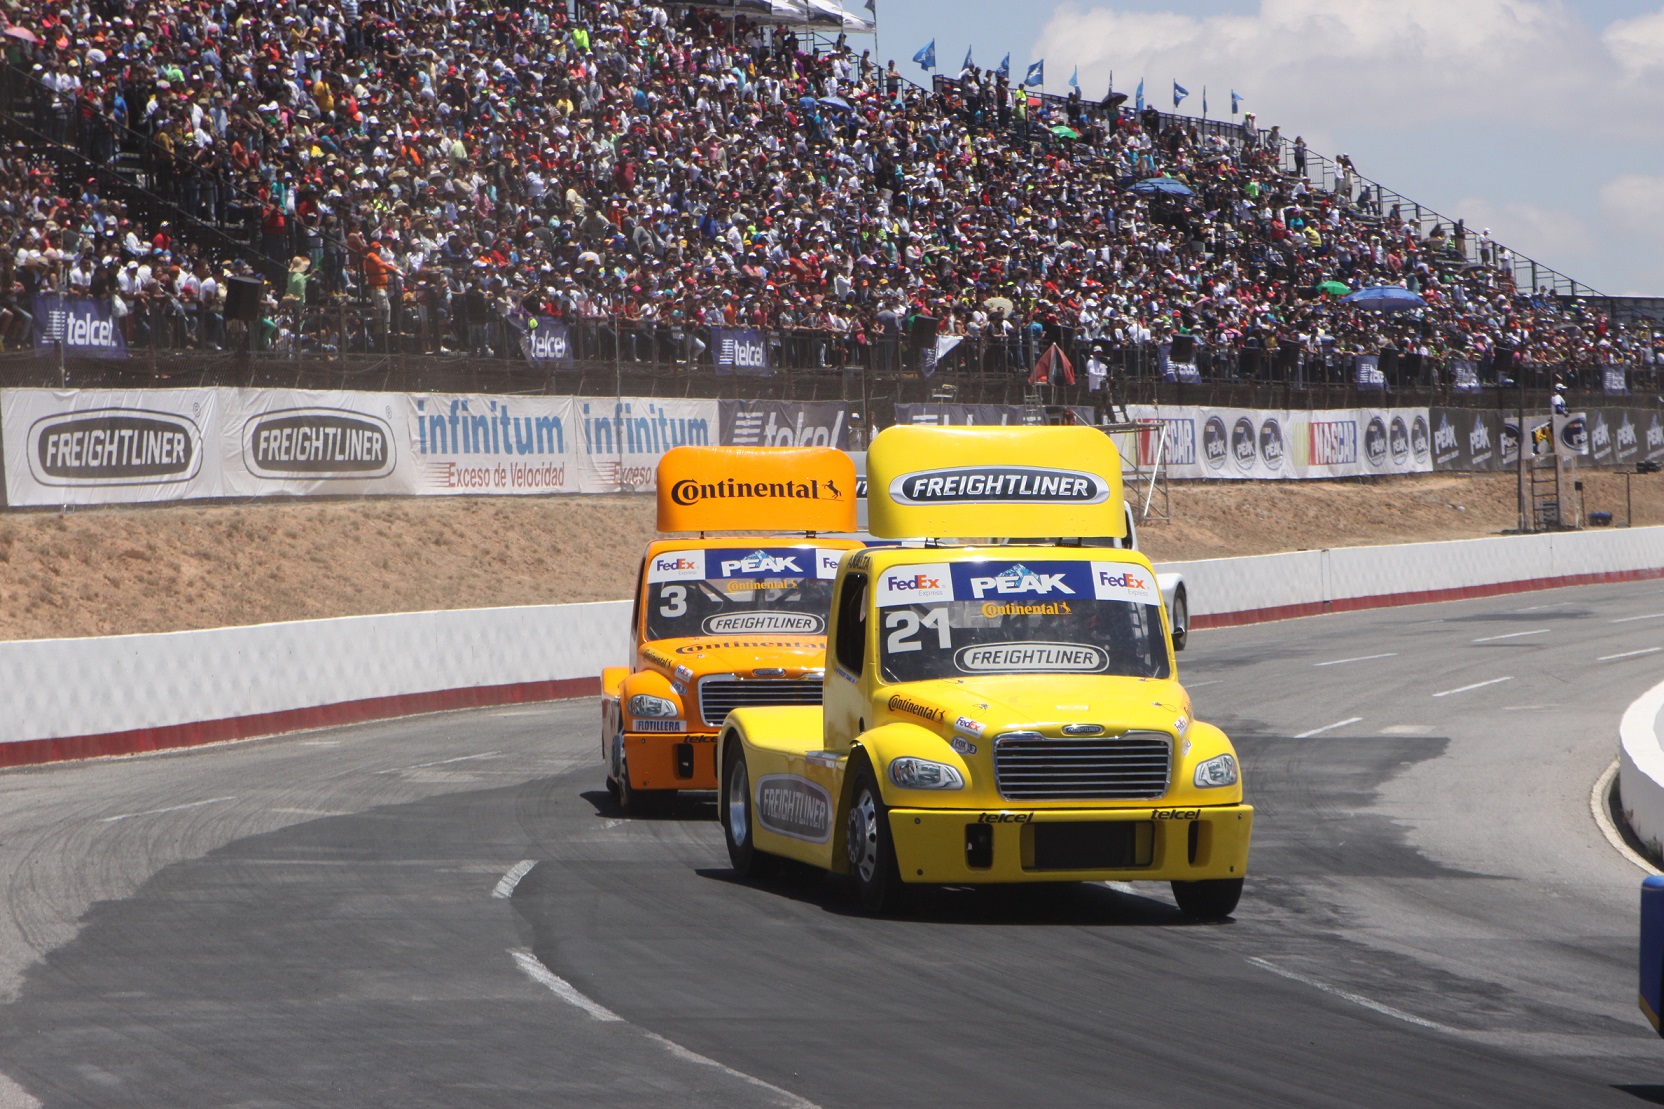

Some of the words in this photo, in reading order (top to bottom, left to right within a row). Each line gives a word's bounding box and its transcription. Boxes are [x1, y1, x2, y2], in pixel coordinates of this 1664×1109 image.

[67, 312, 113, 346] telcel
[530, 330, 567, 358] telcel
[734, 340, 764, 366] telcel
[418, 400, 564, 455] infinitum
[583, 403, 709, 454] infinitum
[1434, 425, 1458, 454] PEAK
[46, 430, 185, 467] FREIGHTLINER
[258, 427, 382, 460] FREIGHTLINER
[1208, 440, 1226, 459] PEAK
[1237, 441, 1256, 460] PEAK
[1313, 421, 1355, 465] NASCAR
[449, 462, 490, 488] Exceso
[494, 462, 506, 487] de
[510, 462, 565, 487] Velocidad
[912, 475, 1088, 497] FREIGHTLINER
[671, 478, 819, 506] Continental
[656, 558, 695, 571] FedEx
[721, 556, 803, 577] PEAK
[727, 580, 788, 593] Continental
[888, 575, 940, 591] FedEx
[970, 574, 1076, 598] PEAK
[1099, 572, 1144, 590] FedEx
[660, 585, 687, 617] 3
[981, 602, 1060, 619] Continental
[715, 617, 811, 630] FREIGHTLINER
[885, 607, 952, 654] 21
[970, 649, 1093, 665] FREIGHTLINER
[888, 694, 937, 720] Continental
[638, 721, 680, 731] FLOTILLERA
[956, 716, 980, 732] FedEx
[763, 788, 826, 829] FREIGHTLINER
[978, 811, 1034, 824] telcel
[1151, 808, 1200, 821] telcel
